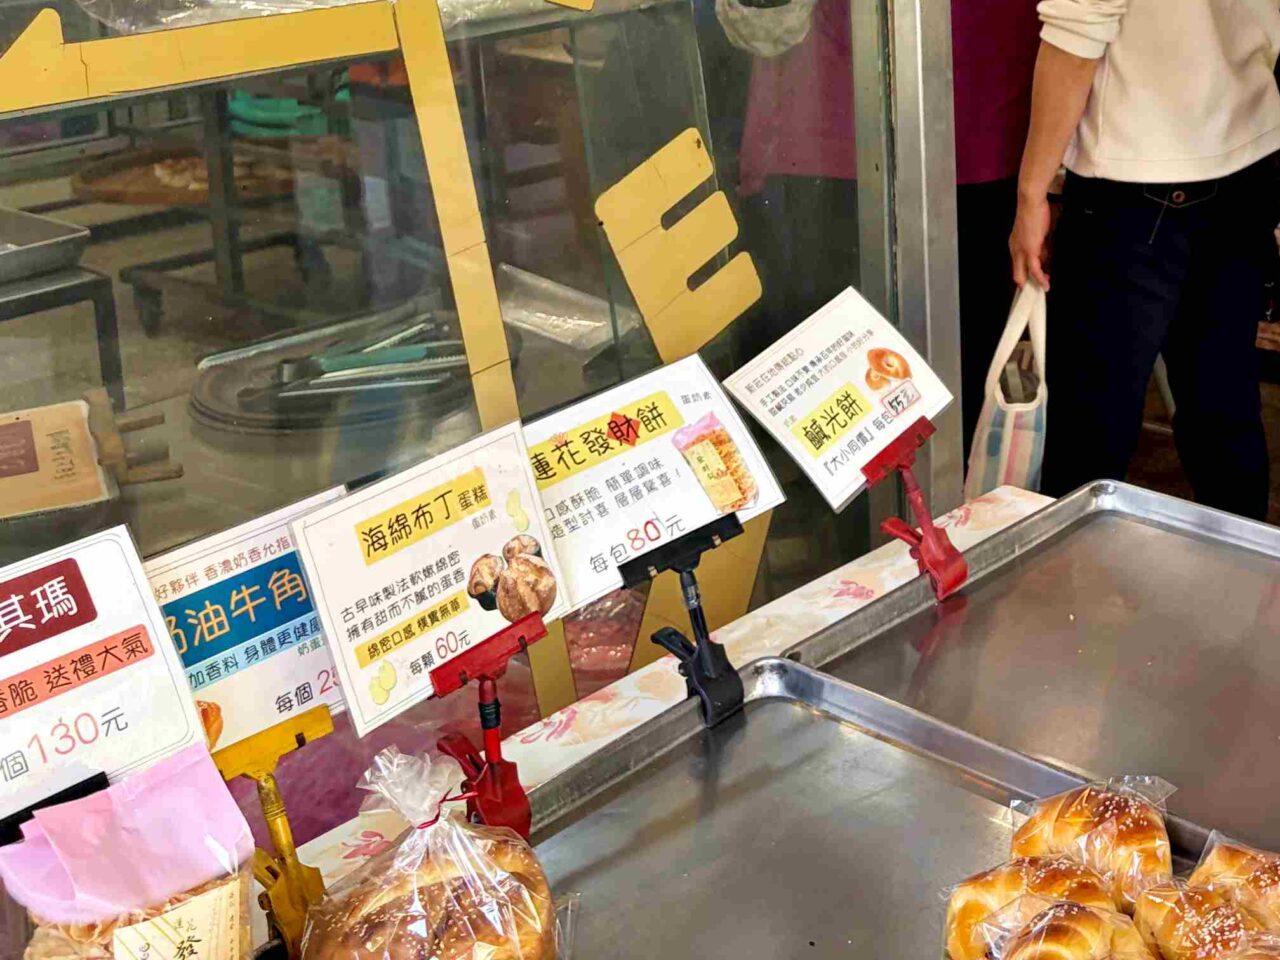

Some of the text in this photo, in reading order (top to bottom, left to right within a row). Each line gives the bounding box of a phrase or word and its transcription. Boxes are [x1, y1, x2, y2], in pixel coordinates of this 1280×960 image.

[530, 401, 669, 481] 蓮花發財餅
[802, 390, 864, 451] 鹹光餅
[605, 457, 664, 492] 簡單調味
[551, 503, 609, 541] 造型討喜
[43, 631, 149, 693] 送禮大氣
[297, 638, 326, 658] 奶蛋
